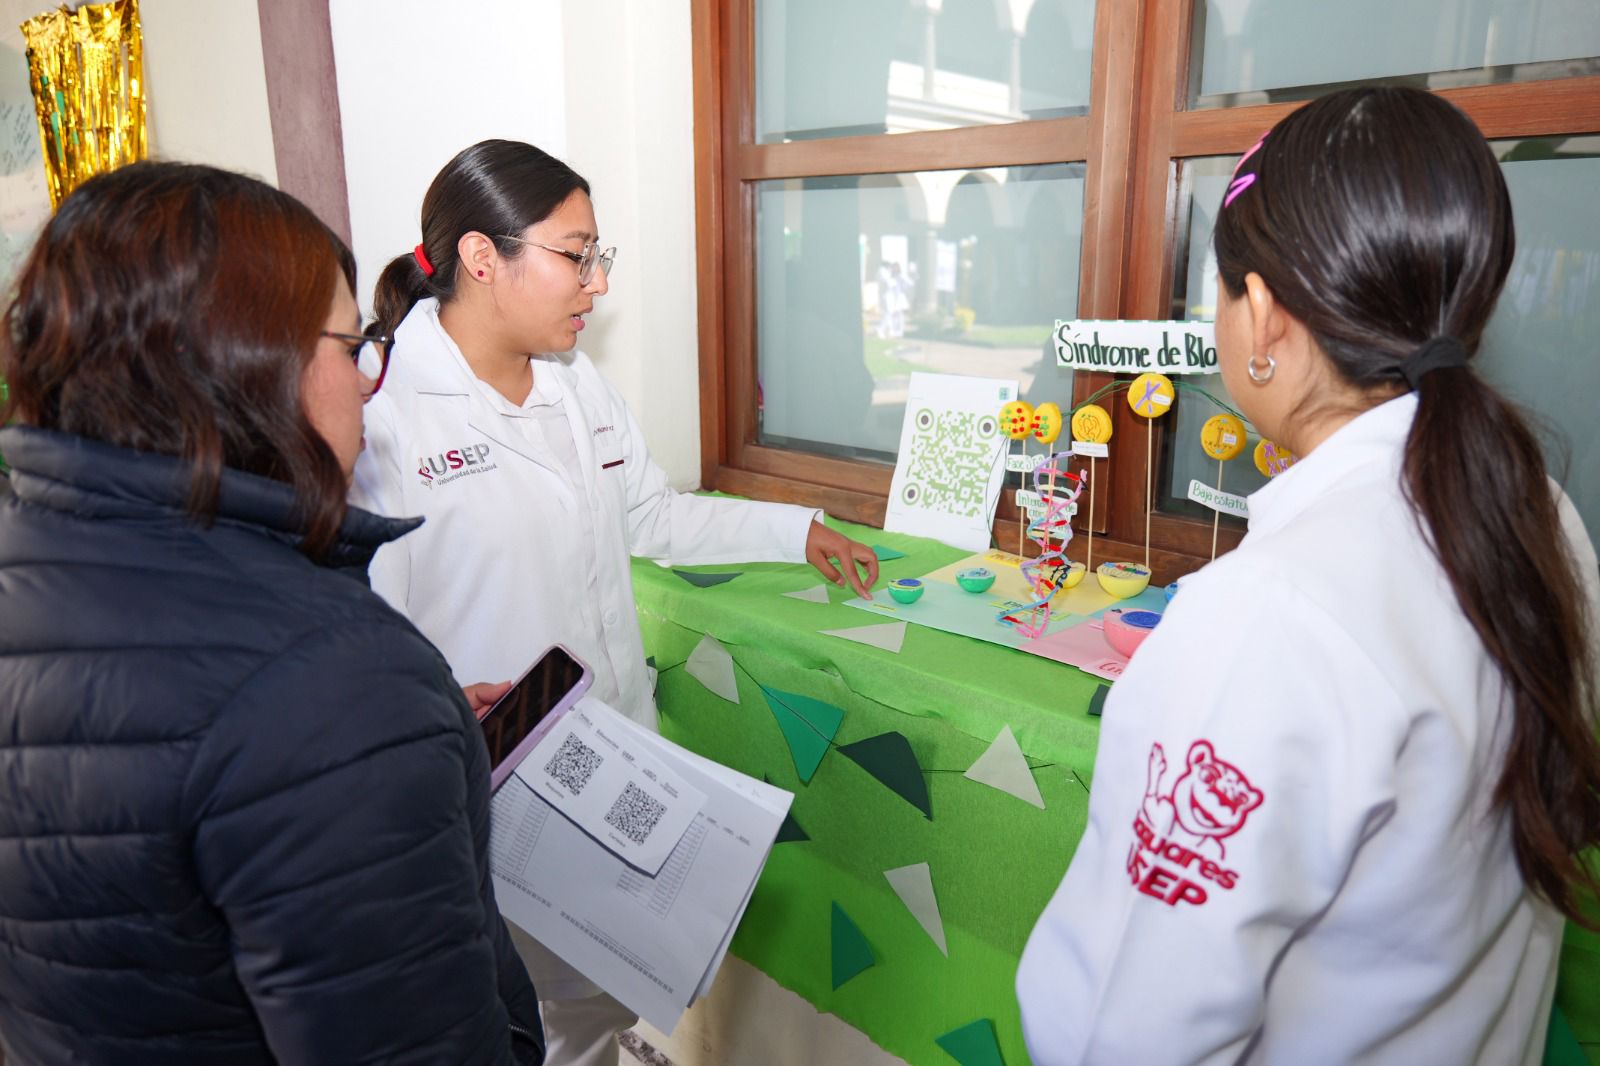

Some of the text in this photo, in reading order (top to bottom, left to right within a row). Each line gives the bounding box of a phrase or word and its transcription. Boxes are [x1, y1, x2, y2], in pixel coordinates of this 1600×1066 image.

[1058, 323, 1152, 368] Síndrome
[1157, 331, 1182, 366] de
[427, 442, 490, 477] USEP
[1193, 482, 1213, 503] Baja
